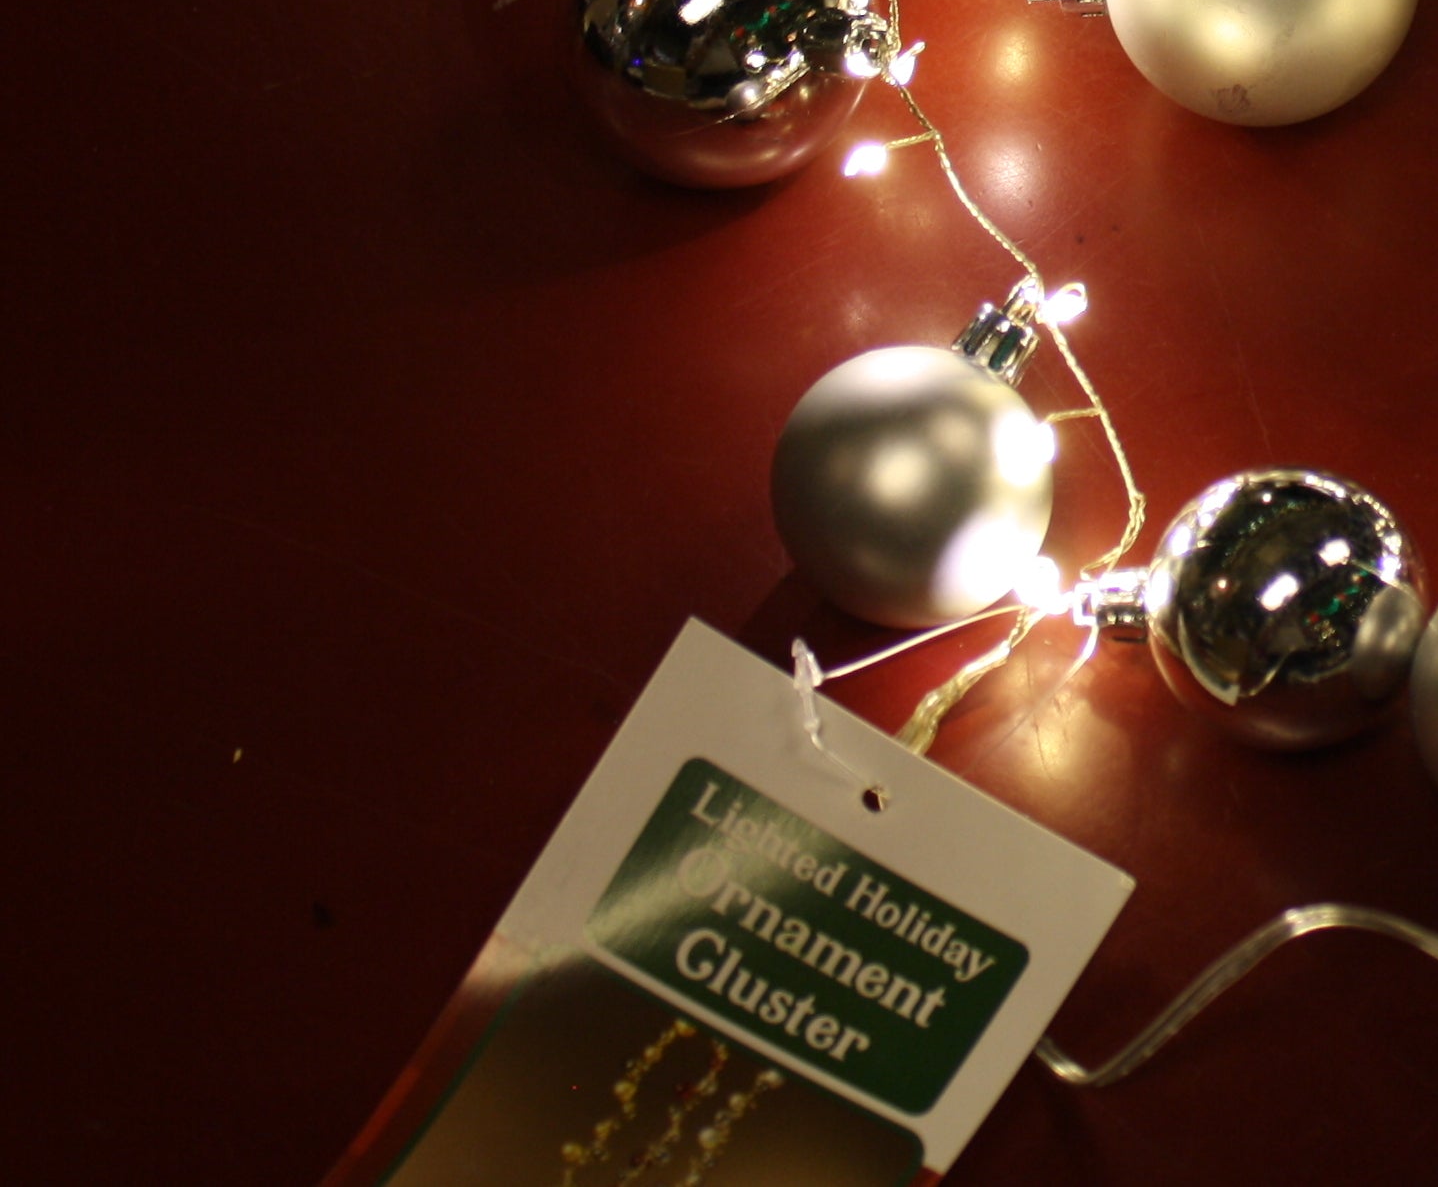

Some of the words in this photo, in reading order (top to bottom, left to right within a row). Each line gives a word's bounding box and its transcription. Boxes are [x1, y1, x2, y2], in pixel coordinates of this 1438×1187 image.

[678, 847, 946, 1028] Ornament
[691, 782, 848, 897] Lighted
[846, 873, 996, 983] Holiday
[675, 927, 871, 1062] Cluster
